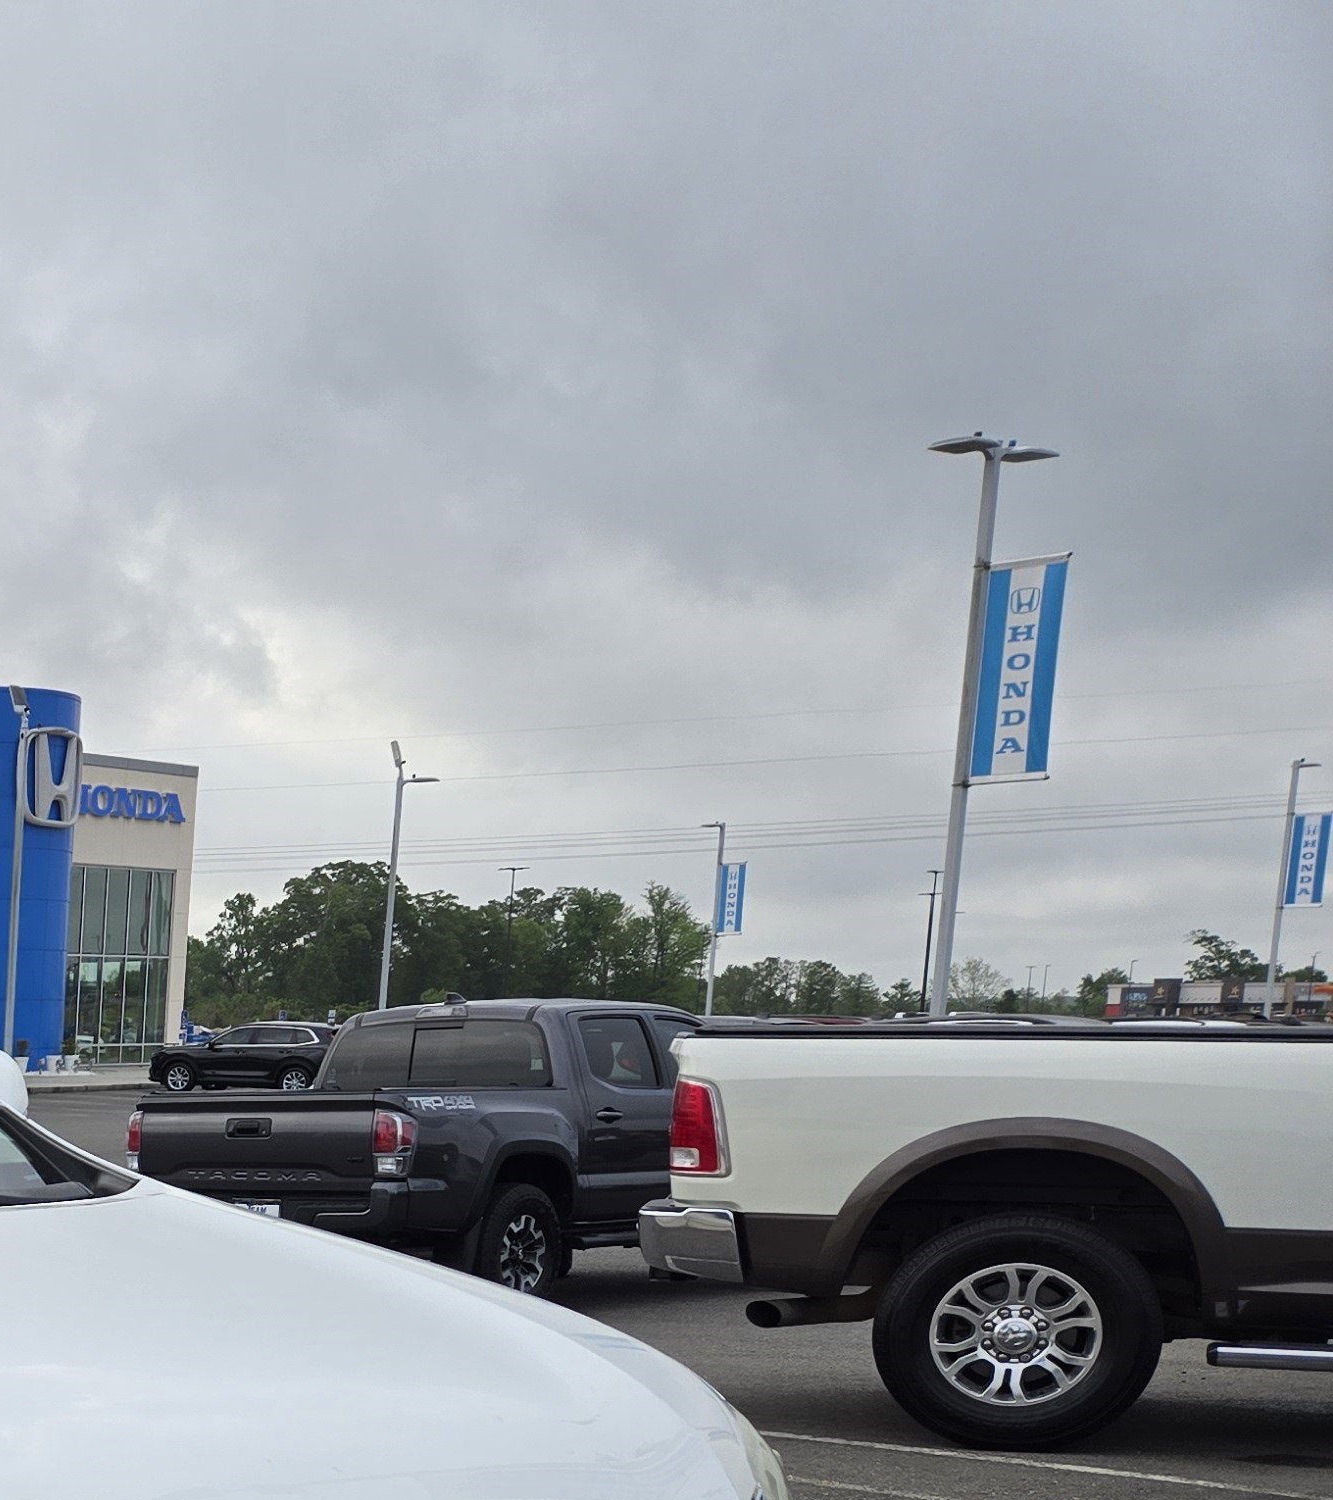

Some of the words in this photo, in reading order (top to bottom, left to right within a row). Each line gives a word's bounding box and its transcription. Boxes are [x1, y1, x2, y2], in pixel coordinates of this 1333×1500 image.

[995, 623, 1035, 755] HONDA
[1297, 840, 1316, 895] HONDA
[407, 1095, 444, 1111] TRD
[187, 1170, 322, 1182] TACOMA
